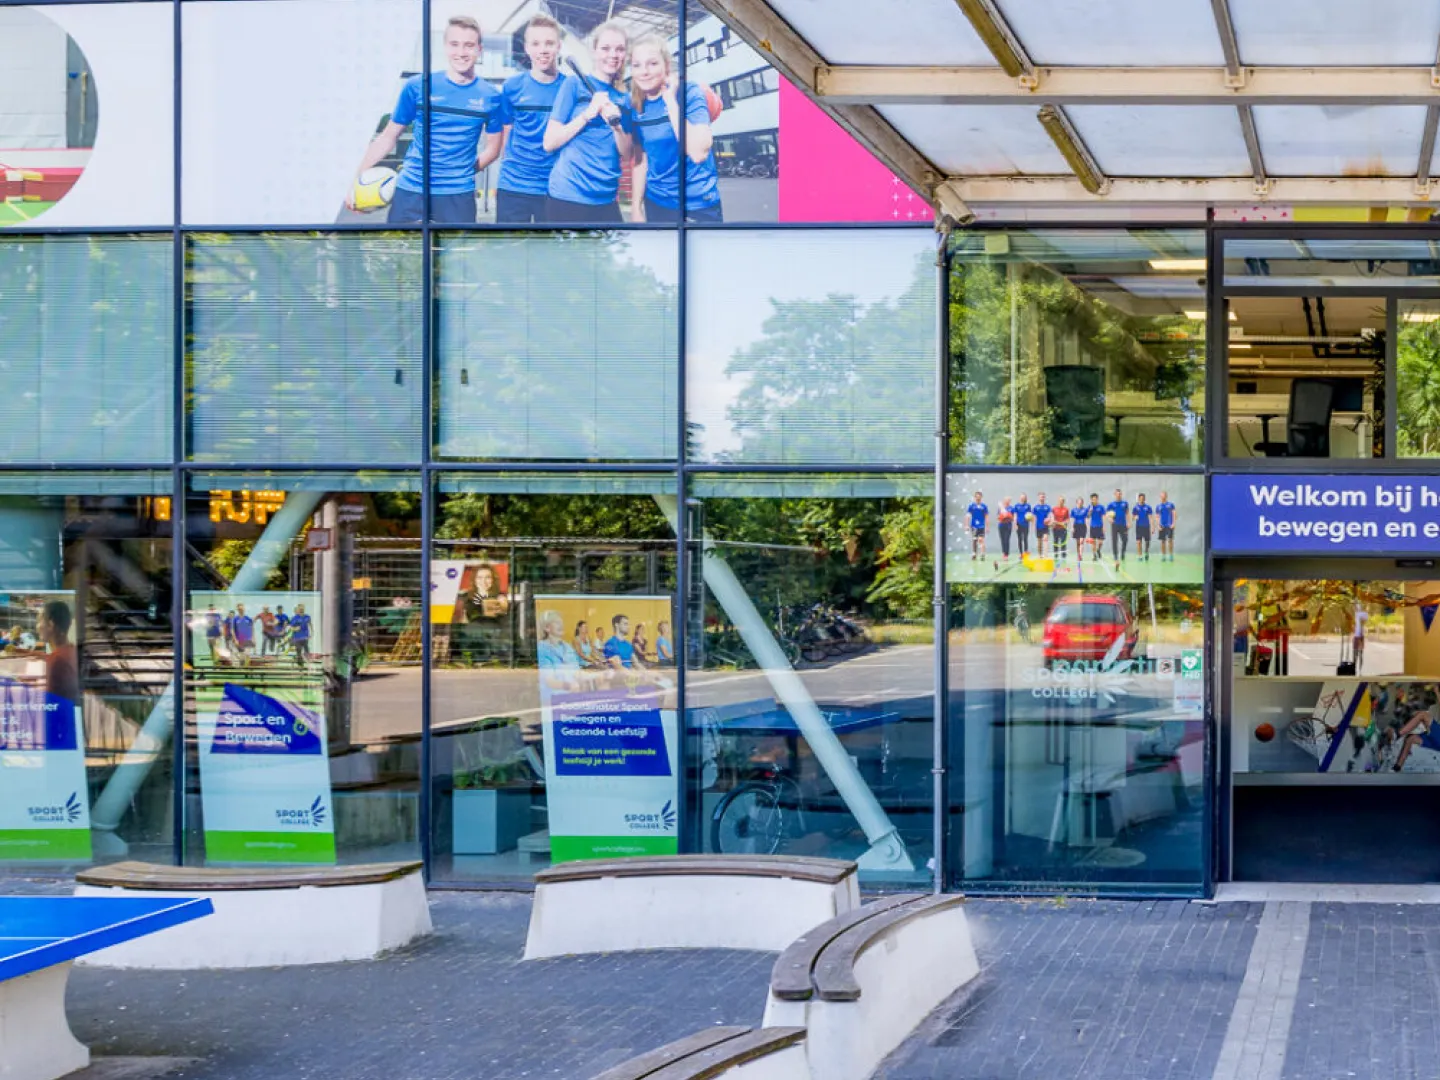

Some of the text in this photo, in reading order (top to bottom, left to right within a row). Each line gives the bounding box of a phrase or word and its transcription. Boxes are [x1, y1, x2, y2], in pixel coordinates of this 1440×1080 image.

[1249, 484, 1367, 507] Welkom
[1375, 484, 1412, 513] bij
[1258, 515, 1378, 543] bewegen
[1384, 521, 1417, 538] en
[1031, 687, 1097, 699] COLLEGE
[224, 712, 286, 727] Sport en
[608, 715, 622, 724] en
[225, 730, 292, 746] Bewegen
[561, 727, 648, 738] Gezonde Leefstijl
[621, 747, 657, 757] gezonde
[28, 806, 64, 815] SPORT
[276, 809, 310, 818] SPORT
[624, 813, 660, 822] SPORT
